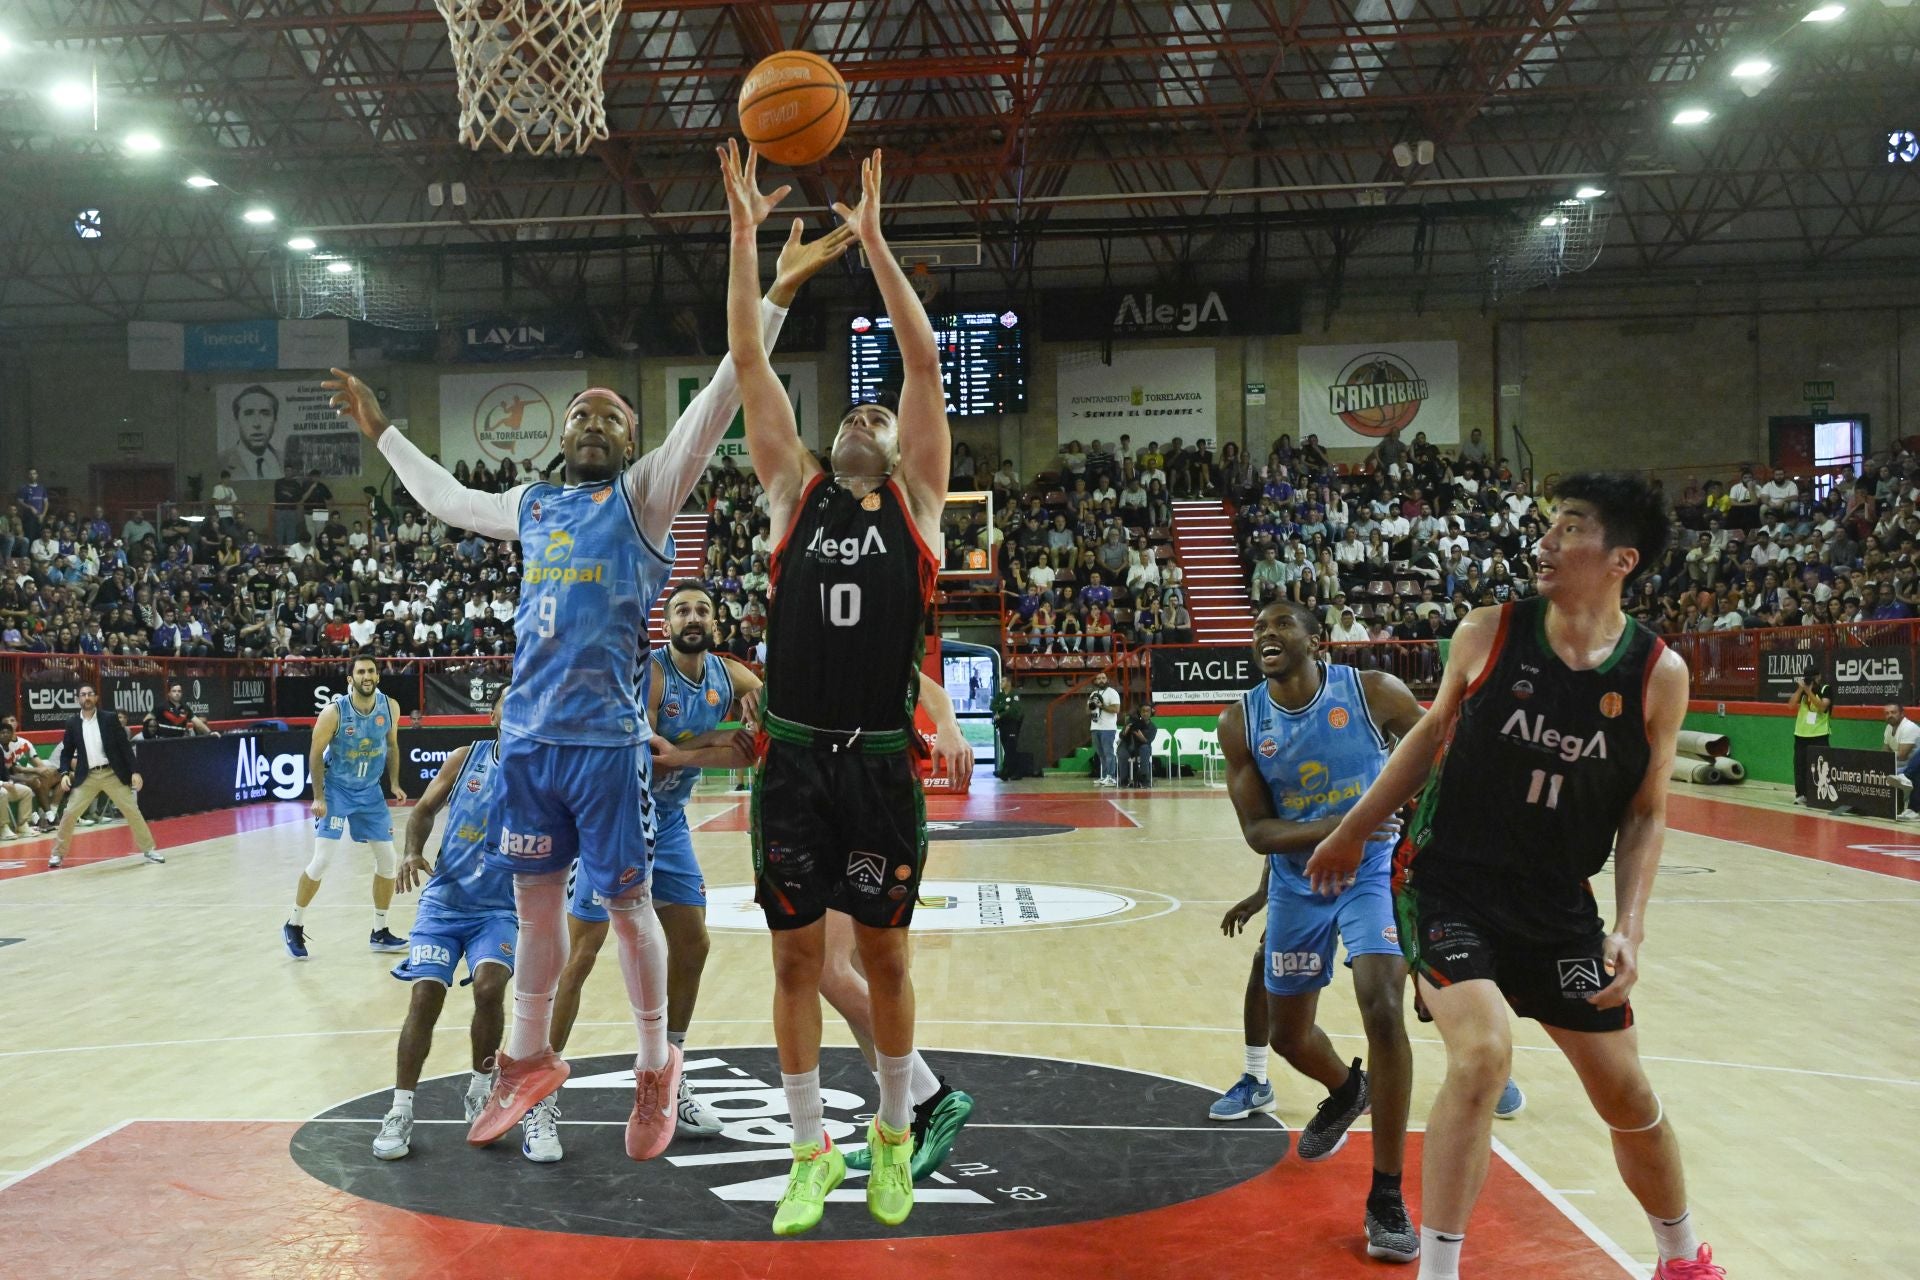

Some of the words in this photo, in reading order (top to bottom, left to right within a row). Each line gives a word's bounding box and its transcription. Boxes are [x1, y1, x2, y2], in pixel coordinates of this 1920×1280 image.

[1113, 291, 1229, 331] AlegA
[1071, 395, 1130, 404] AYUNTAMIENTO
[1145, 393, 1202, 401] TORRELAVEGA
[1331, 380, 1428, 414] CANTABRIA
[496, 430, 548, 440] TORRELAVEGA
[710, 444, 749, 456] REL
[537, 596, 557, 638] 9
[1175, 661, 1249, 681] TAGLE
[1768, 655, 1779, 675] EL
[29, 688, 81, 710] tekti
[114, 680, 154, 712] úniko
[242, 680, 265, 697] DIARIO
[1500, 708, 1607, 762] AlegA
[235, 736, 313, 800] Aleg
[357, 761, 369, 777] 11
[1831, 767, 1862, 783] Quimera
[1282, 782, 1362, 810] agropal
[1526, 768, 1565, 810] 11
[499, 826, 553, 855] gaza
[411, 943, 451, 964] gaza
[1270, 952, 1321, 977] gaza
